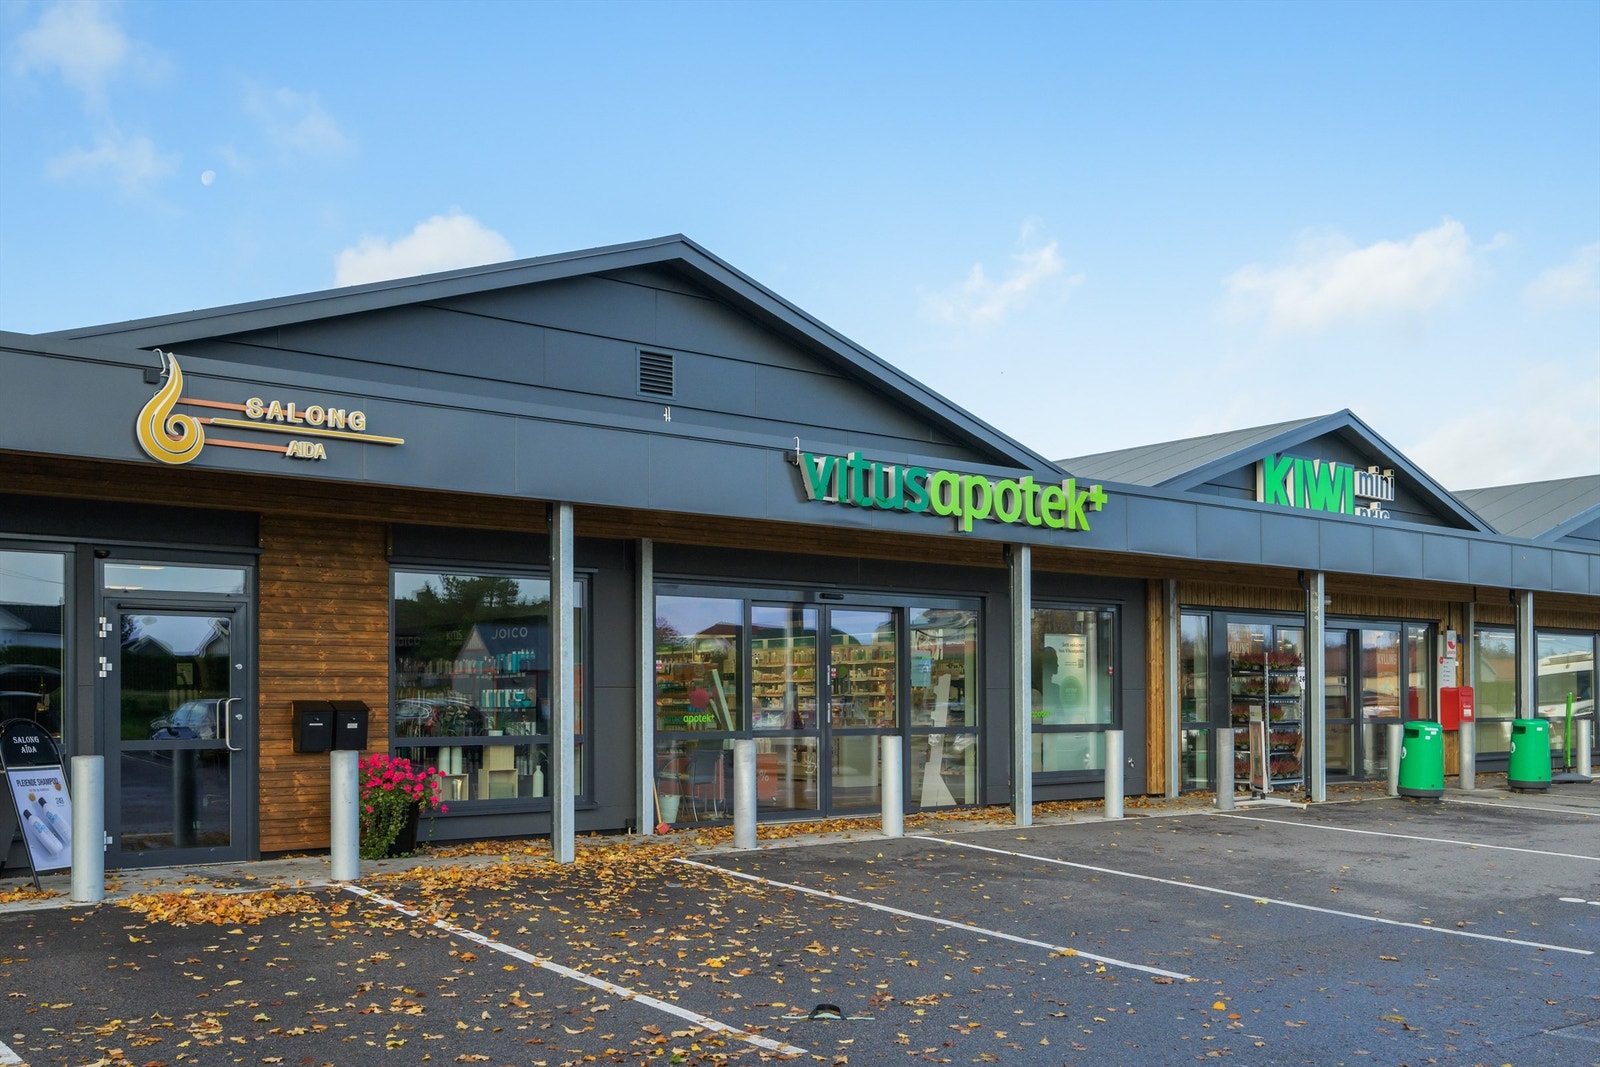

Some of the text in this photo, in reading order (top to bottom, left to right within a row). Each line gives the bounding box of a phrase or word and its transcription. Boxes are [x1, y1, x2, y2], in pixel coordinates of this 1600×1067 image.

[245, 397, 367, 431] SALONG
[286, 439, 327, 460] AIDA
[1256, 453, 1355, 516] KIWI
[1354, 465, 1395, 501] mini
[491, 627, 528, 640] JOICO
[16, 777, 59, 787] PLEIENDE SHAMPOO
